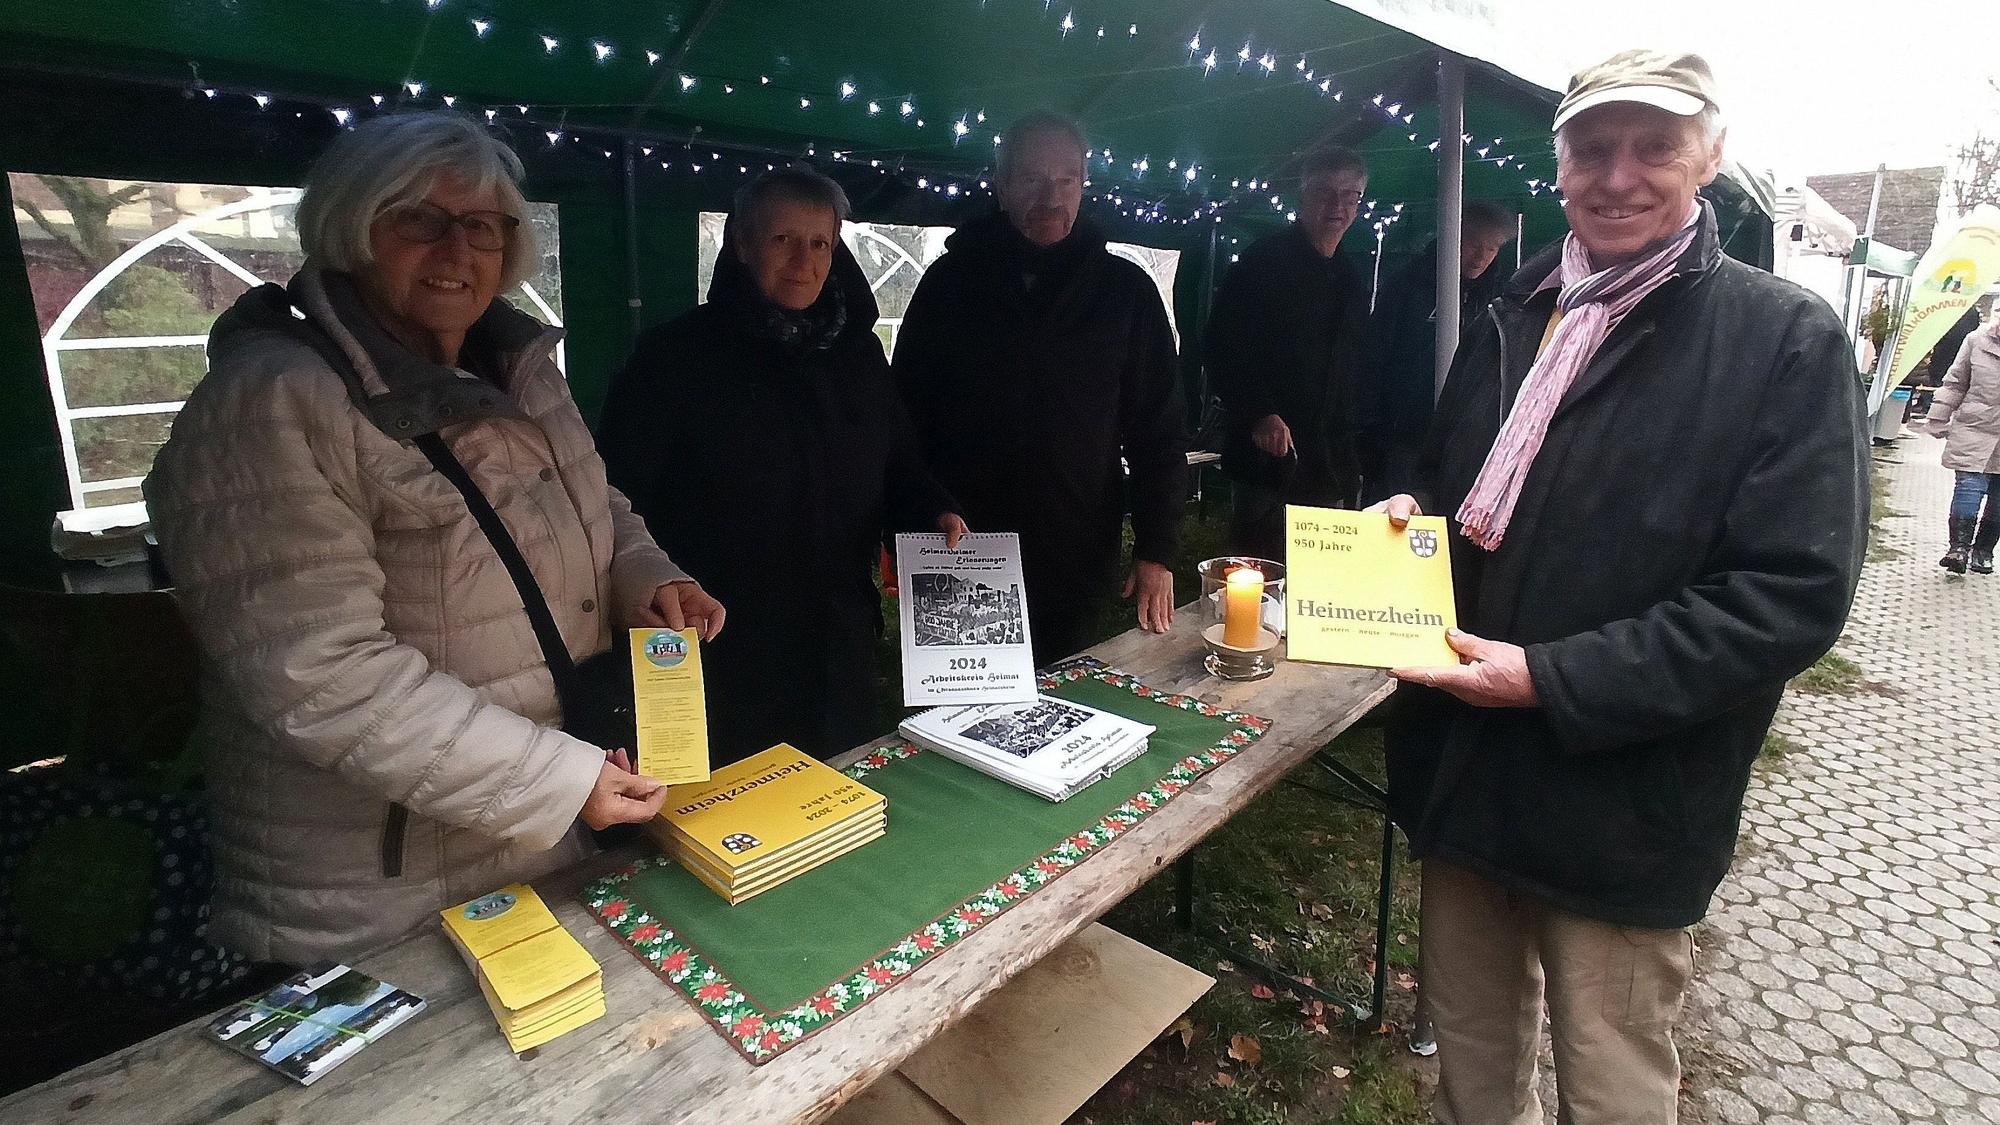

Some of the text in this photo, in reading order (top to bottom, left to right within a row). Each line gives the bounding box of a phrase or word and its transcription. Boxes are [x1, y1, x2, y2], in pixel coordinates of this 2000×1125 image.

[1900, 298, 1967, 346] WILLKOMMEN
[1295, 521, 1320, 533] 1074
[1333, 525, 1358, 536] 2024
[1294, 539, 1352, 552] 950 Jahre
[1296, 599, 1444, 627] Heimerzheim
[949, 657, 987, 670] 2024
[921, 672, 1019, 685] Arbeitskreis Heimat
[1061, 735, 1092, 753] 2024
[675, 760, 812, 816] Heimerzheim
[799, 784, 854, 810] 950 Jahre
[840, 791, 867, 805] 1074
[805, 808, 833, 822] 2024
